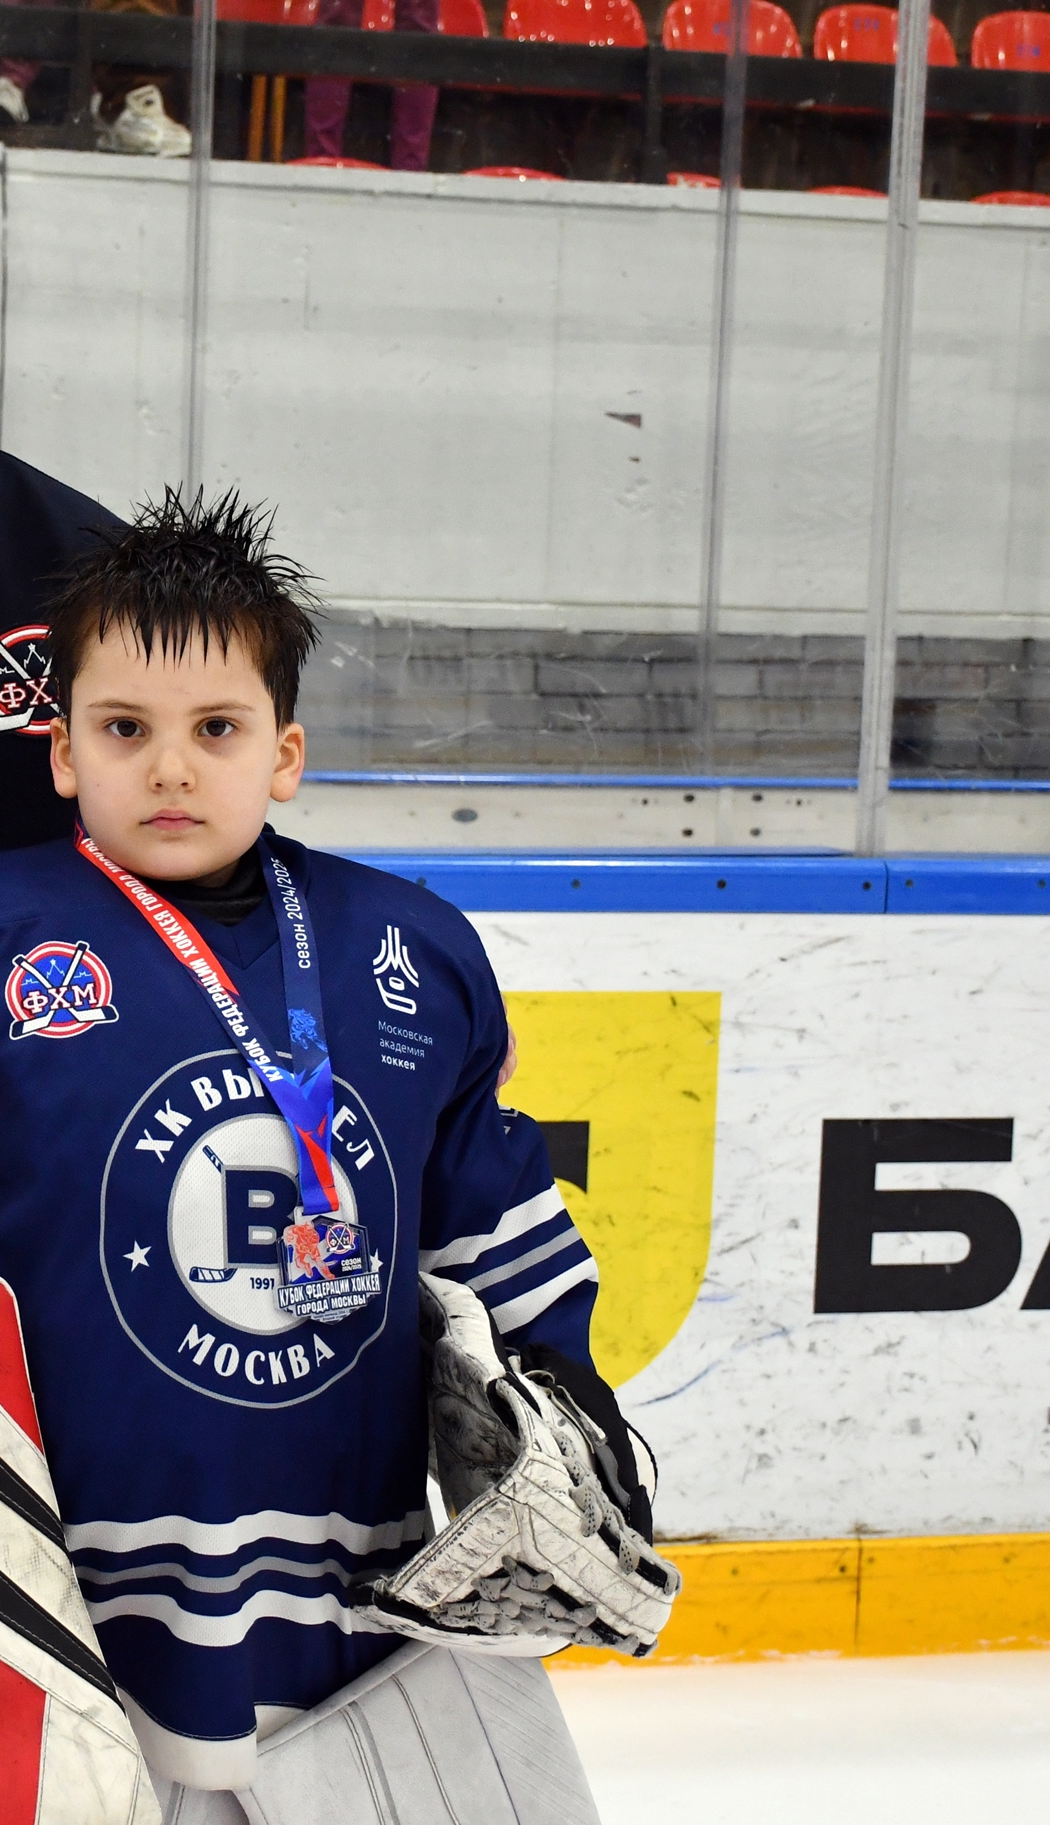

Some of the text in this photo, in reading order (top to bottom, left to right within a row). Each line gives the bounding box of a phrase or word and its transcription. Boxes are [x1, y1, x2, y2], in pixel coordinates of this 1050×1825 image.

[118, 874, 163, 912] ГОРОДА
[153, 909, 200, 959] ХОККЕЯ
[293, 923, 311, 969] сезон
[23, 982, 98, 1014] ФХМ
[189, 957, 249, 1037] ФЕДЕРАЦИИ
[378, 1020, 434, 1046] Московская
[379, 1038, 425, 1058] академия
[242, 1037, 284, 1082] КУБОК
[381, 1054, 416, 1071] хоккея
[135, 1067, 375, 1171] ХК ВЫЕЛ
[249, 1277, 275, 1290] 1991
[278, 1273, 381, 1307] КУБОК ФЕДЕРАЦИИ ХОККЕЯ
[296, 1299, 329, 1315] ГОРОДА
[331, 1294, 366, 1309] МОСКВЫ
[178, 1323, 335, 1385] МОСКВА
